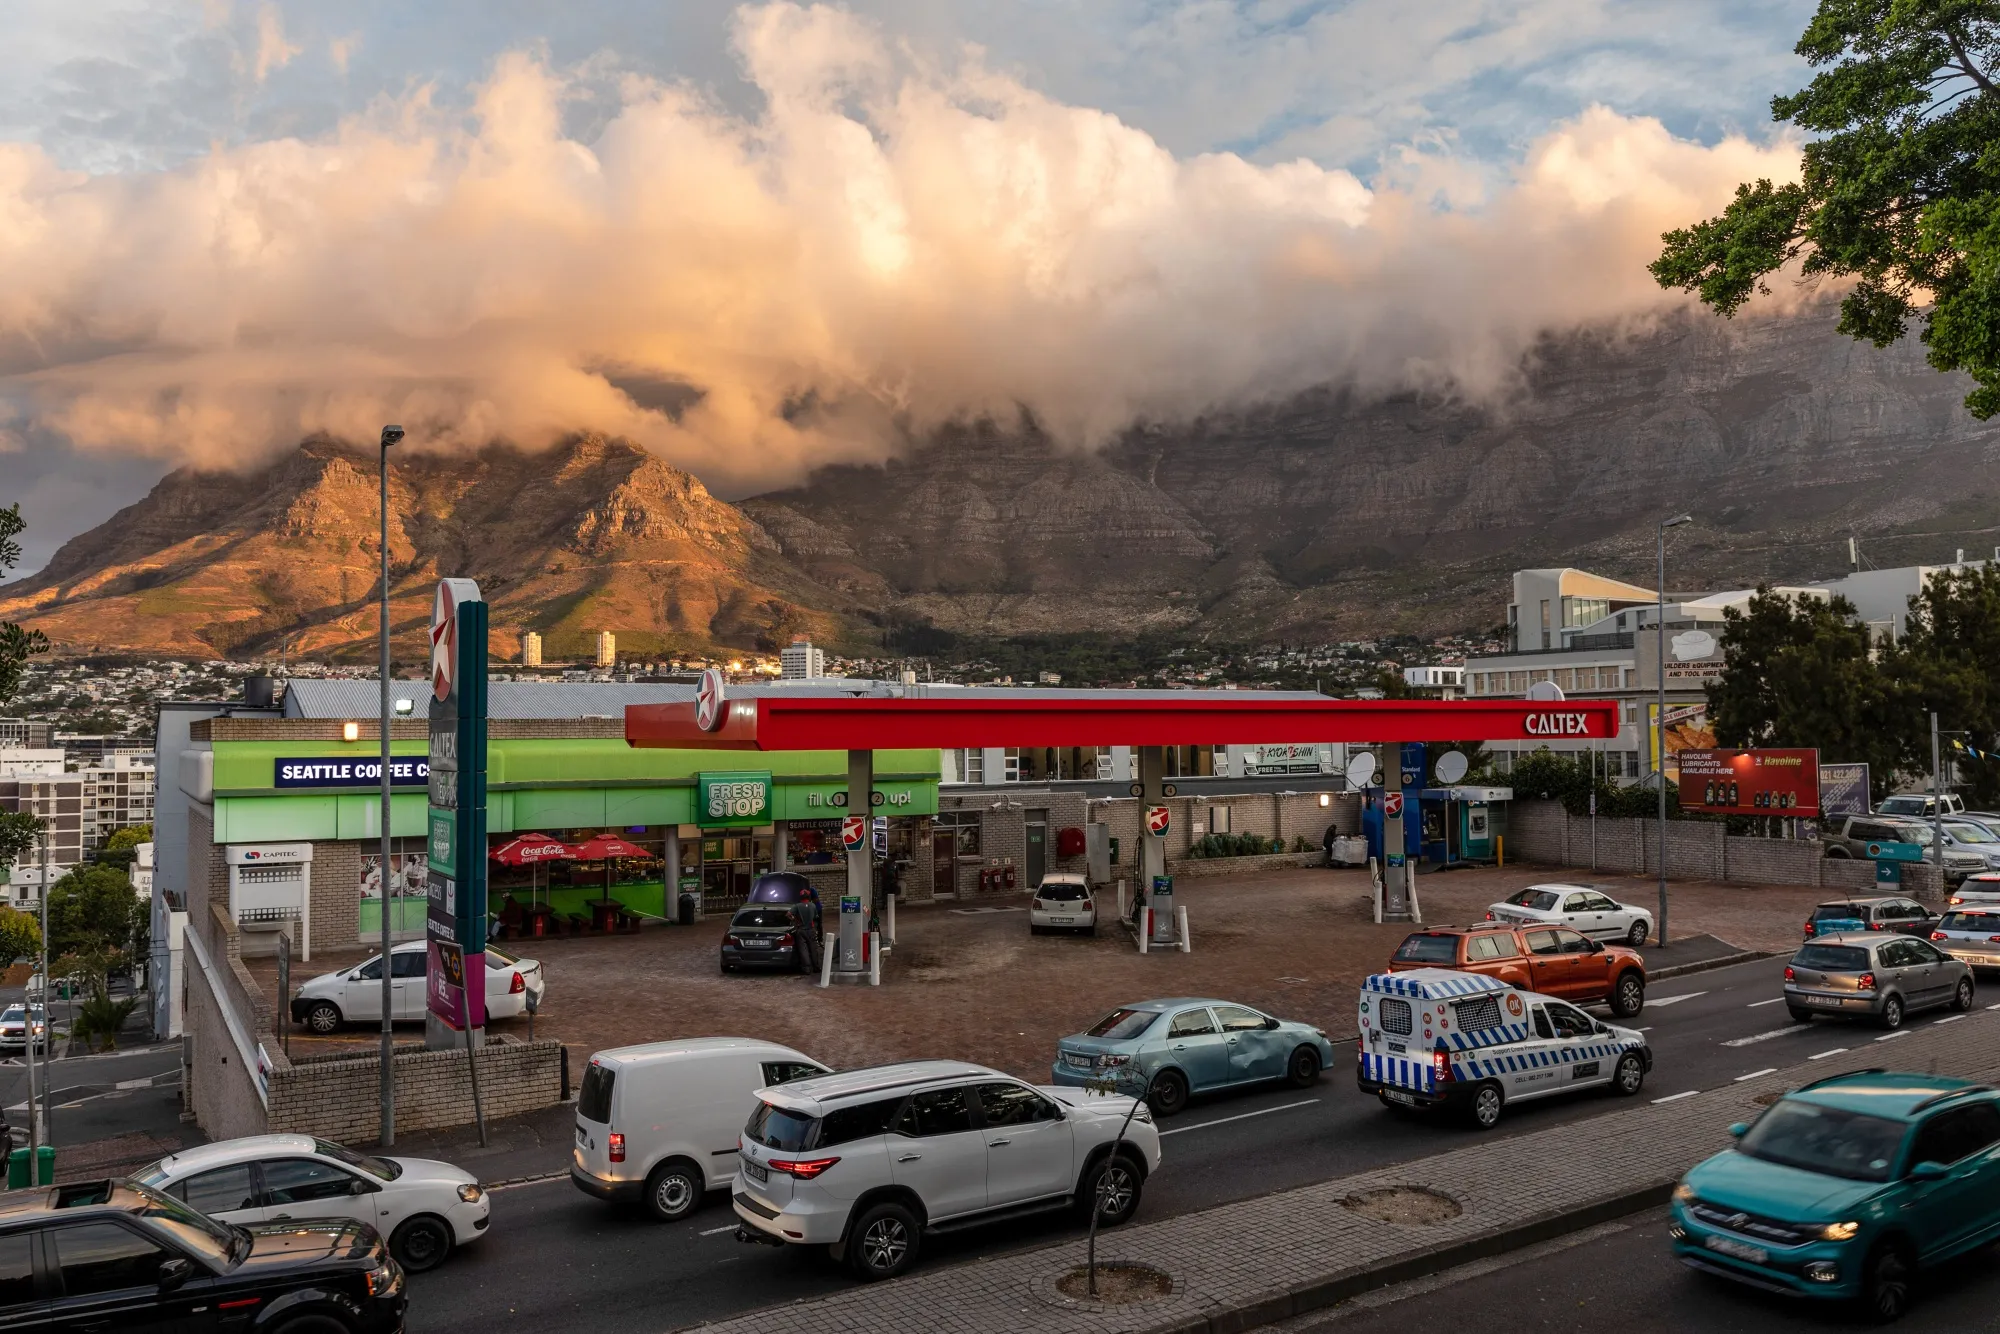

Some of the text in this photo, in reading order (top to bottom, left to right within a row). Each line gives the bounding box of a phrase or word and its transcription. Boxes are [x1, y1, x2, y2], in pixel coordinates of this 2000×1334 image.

[1525, 713, 1589, 734] CALTEX
[430, 733, 456, 758] CALTEX
[1764, 756, 1802, 766] Havoline
[282, 765, 351, 780] SEATTLE
[708, 782, 765, 799] FRESH
[808, 793, 823, 806] fill
[889, 791, 911, 807] up!
[708, 798, 765, 817] STOP
[789, 821, 817, 829] SEATTLE
[520, 845, 565, 856] Coca-Cola
[1510, 999, 1520, 1011] OK
[1492, 1046, 1511, 1055] Support
[1524, 1043, 1548, 1052] Prevention
